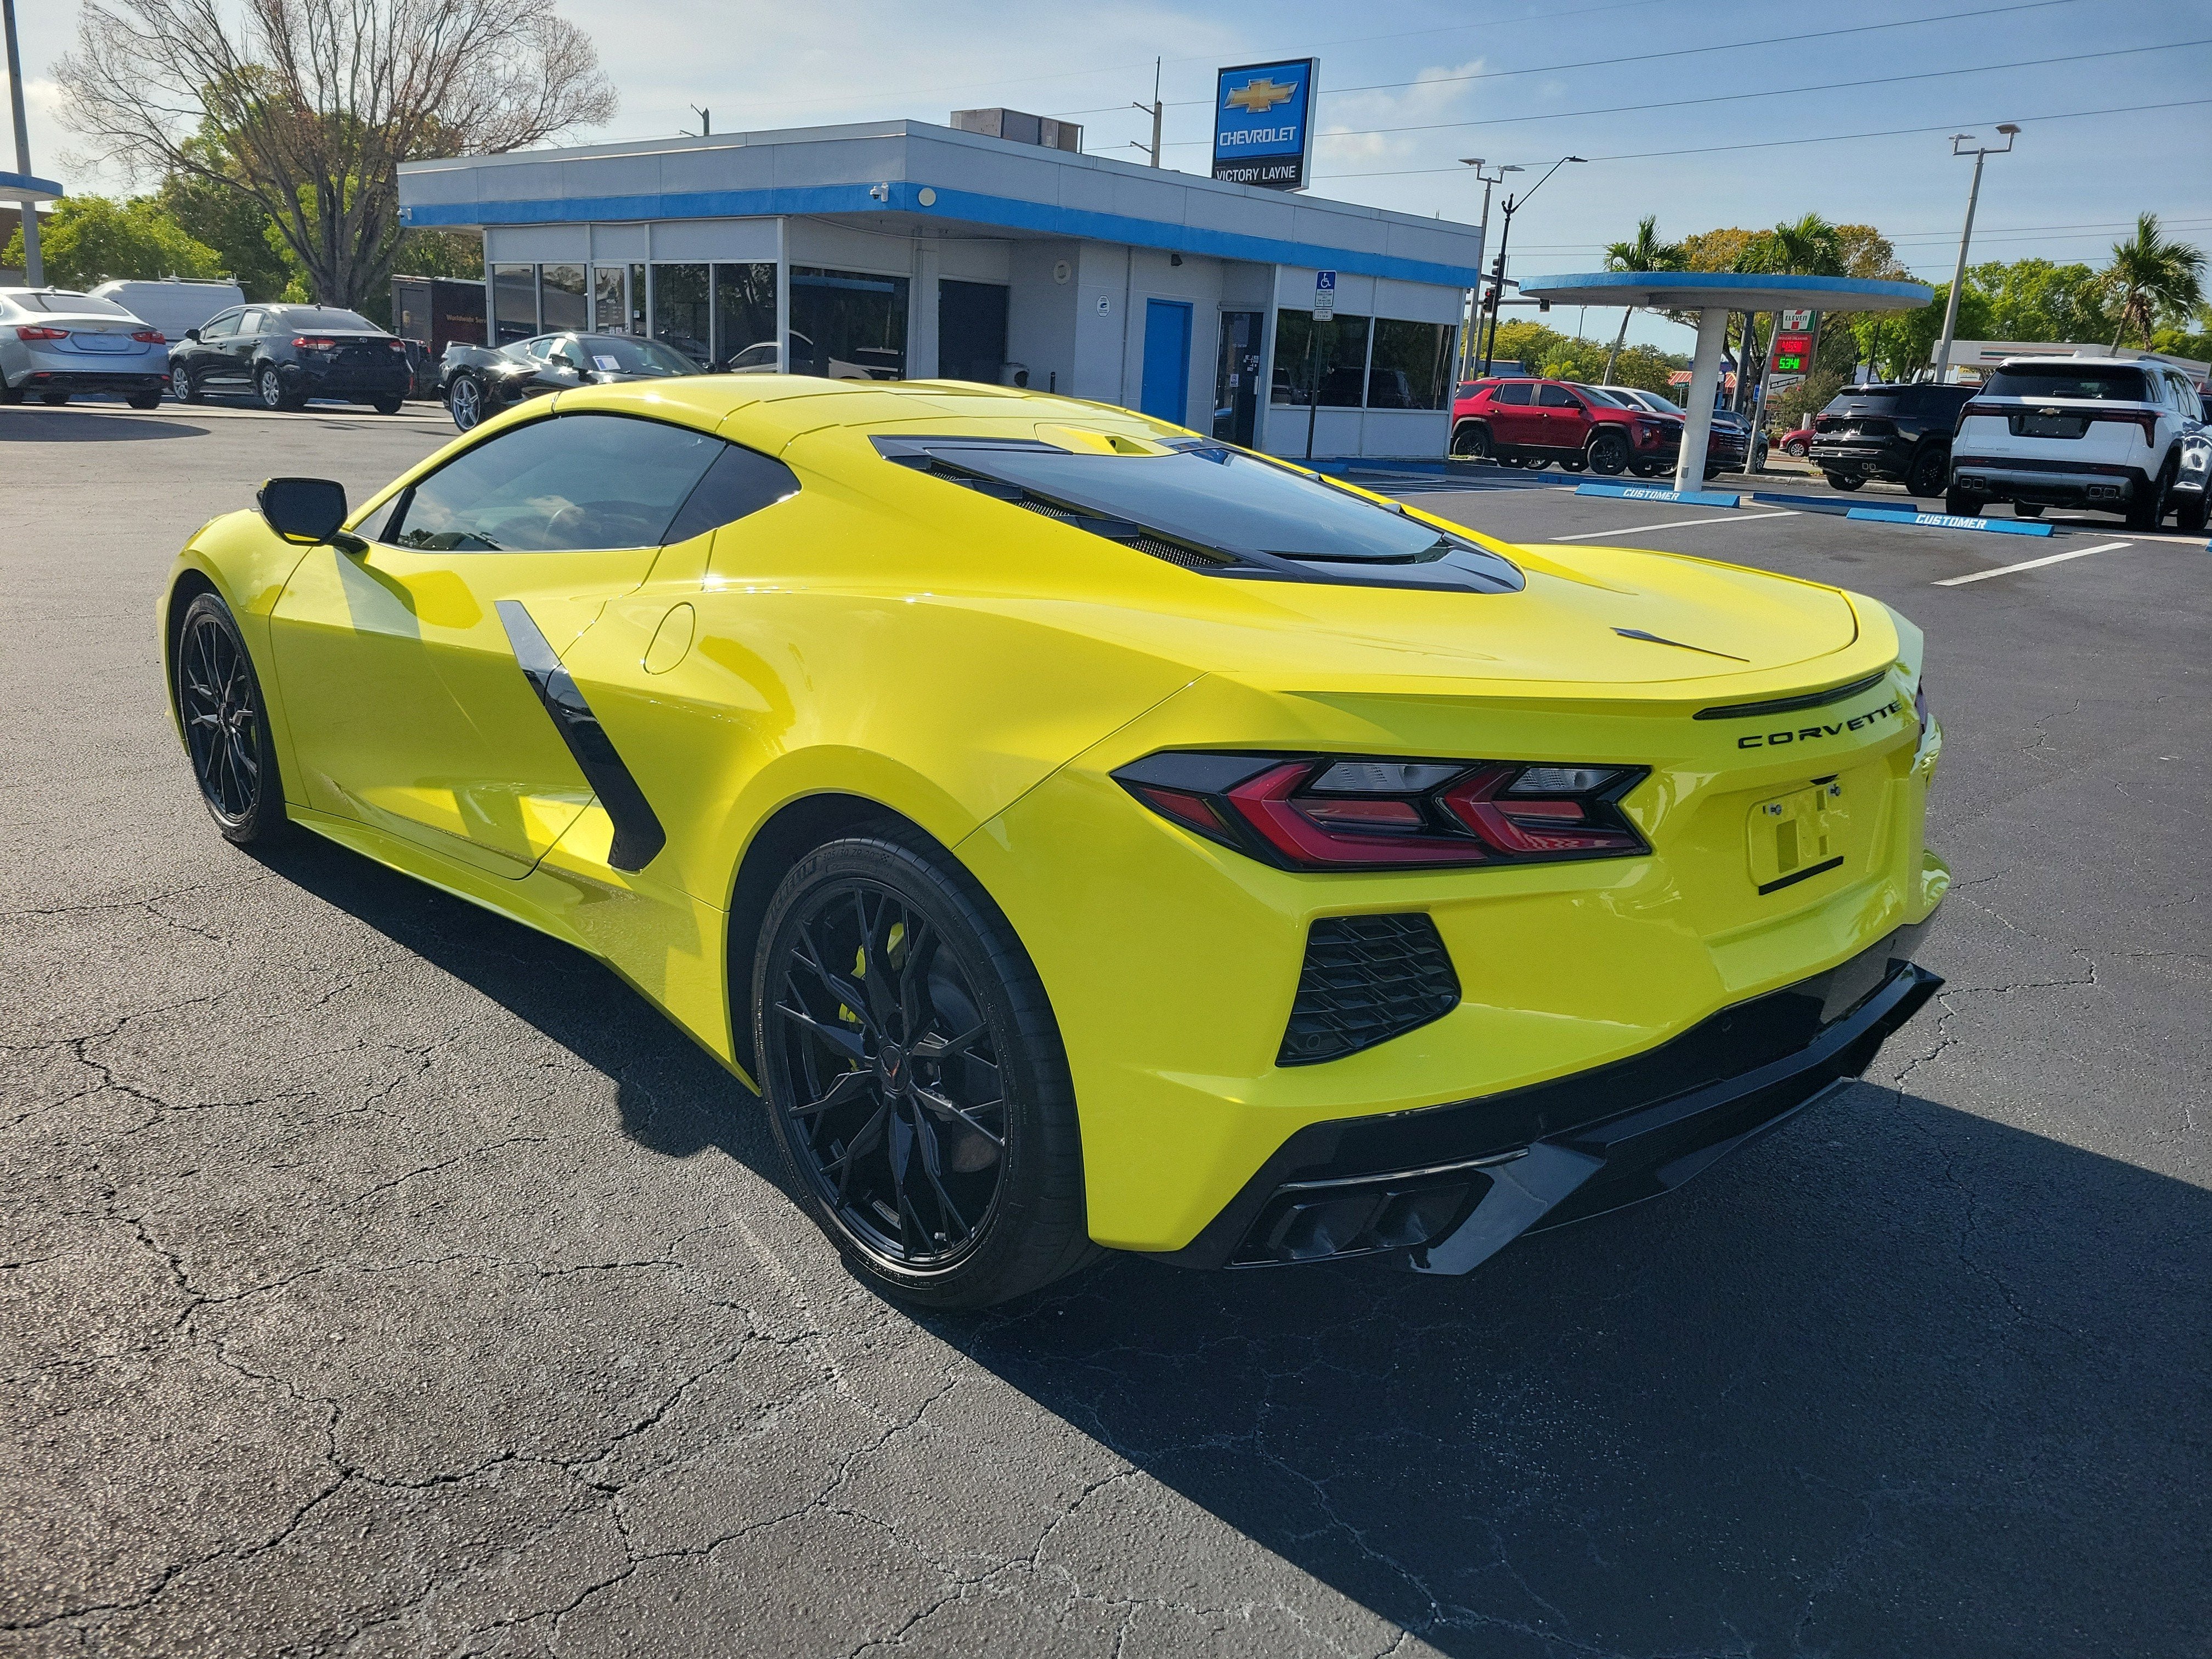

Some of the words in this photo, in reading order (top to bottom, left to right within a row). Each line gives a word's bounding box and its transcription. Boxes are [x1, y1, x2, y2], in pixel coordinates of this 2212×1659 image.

[1220, 126, 1296, 146] CHEVROLET
[1216, 168, 1260, 182] VICTORY
[1262, 165, 1296, 180] LAYNE
[1623, 489, 1680, 500] CUSTOMER
[1915, 514, 1987, 529] CUSTOMER
[1738, 699, 1903, 749] CORVETTE
